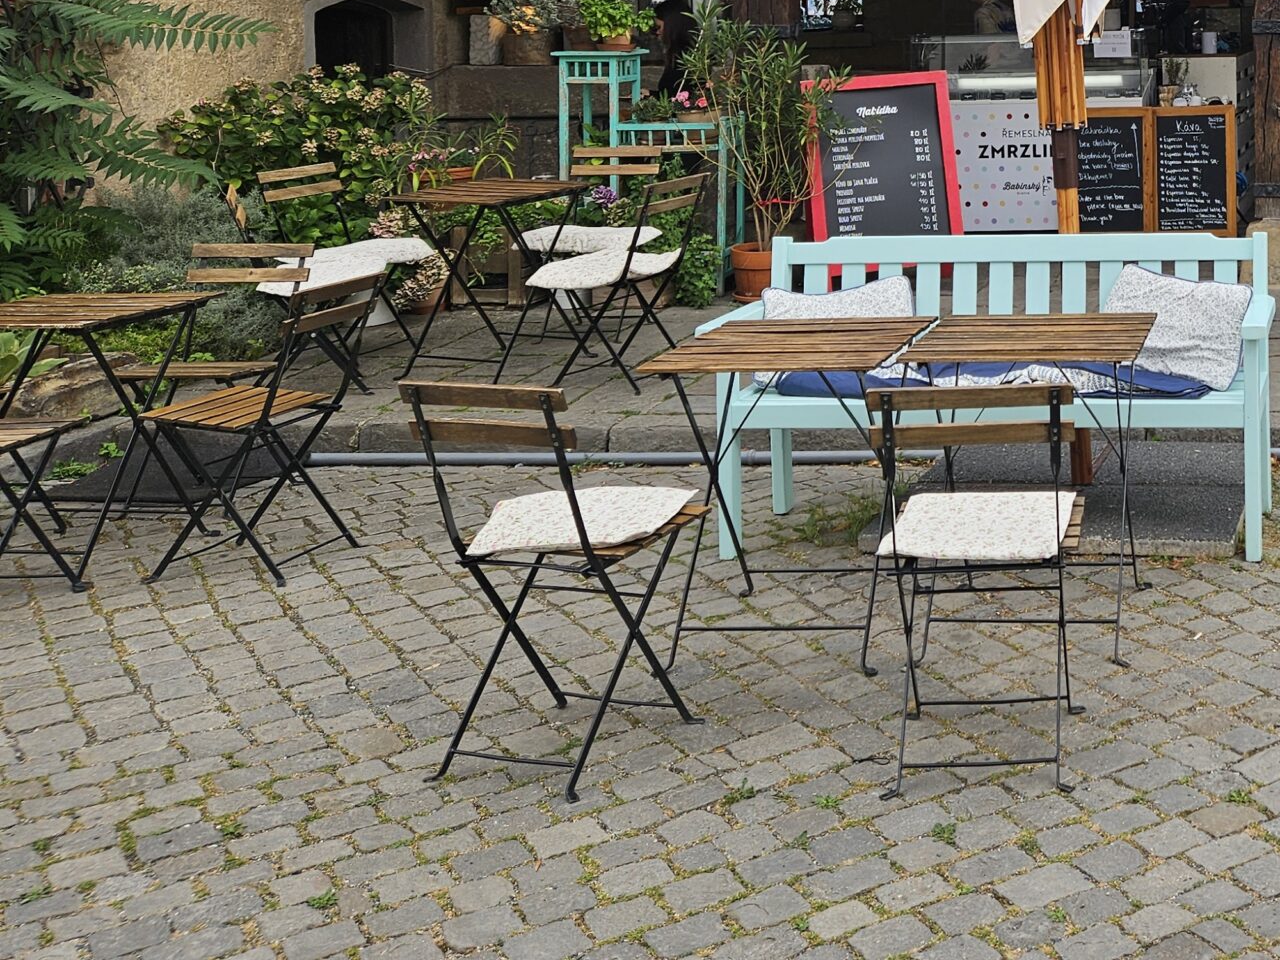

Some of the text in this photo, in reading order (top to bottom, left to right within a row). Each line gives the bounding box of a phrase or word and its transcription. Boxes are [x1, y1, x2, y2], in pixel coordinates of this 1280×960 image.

[856, 104, 898, 118] Nabídka
[1175, 120, 1202, 132] Káva
[978, 144, 1053, 158] ZMRZLI
[1003, 181, 1041, 192] Babinský
